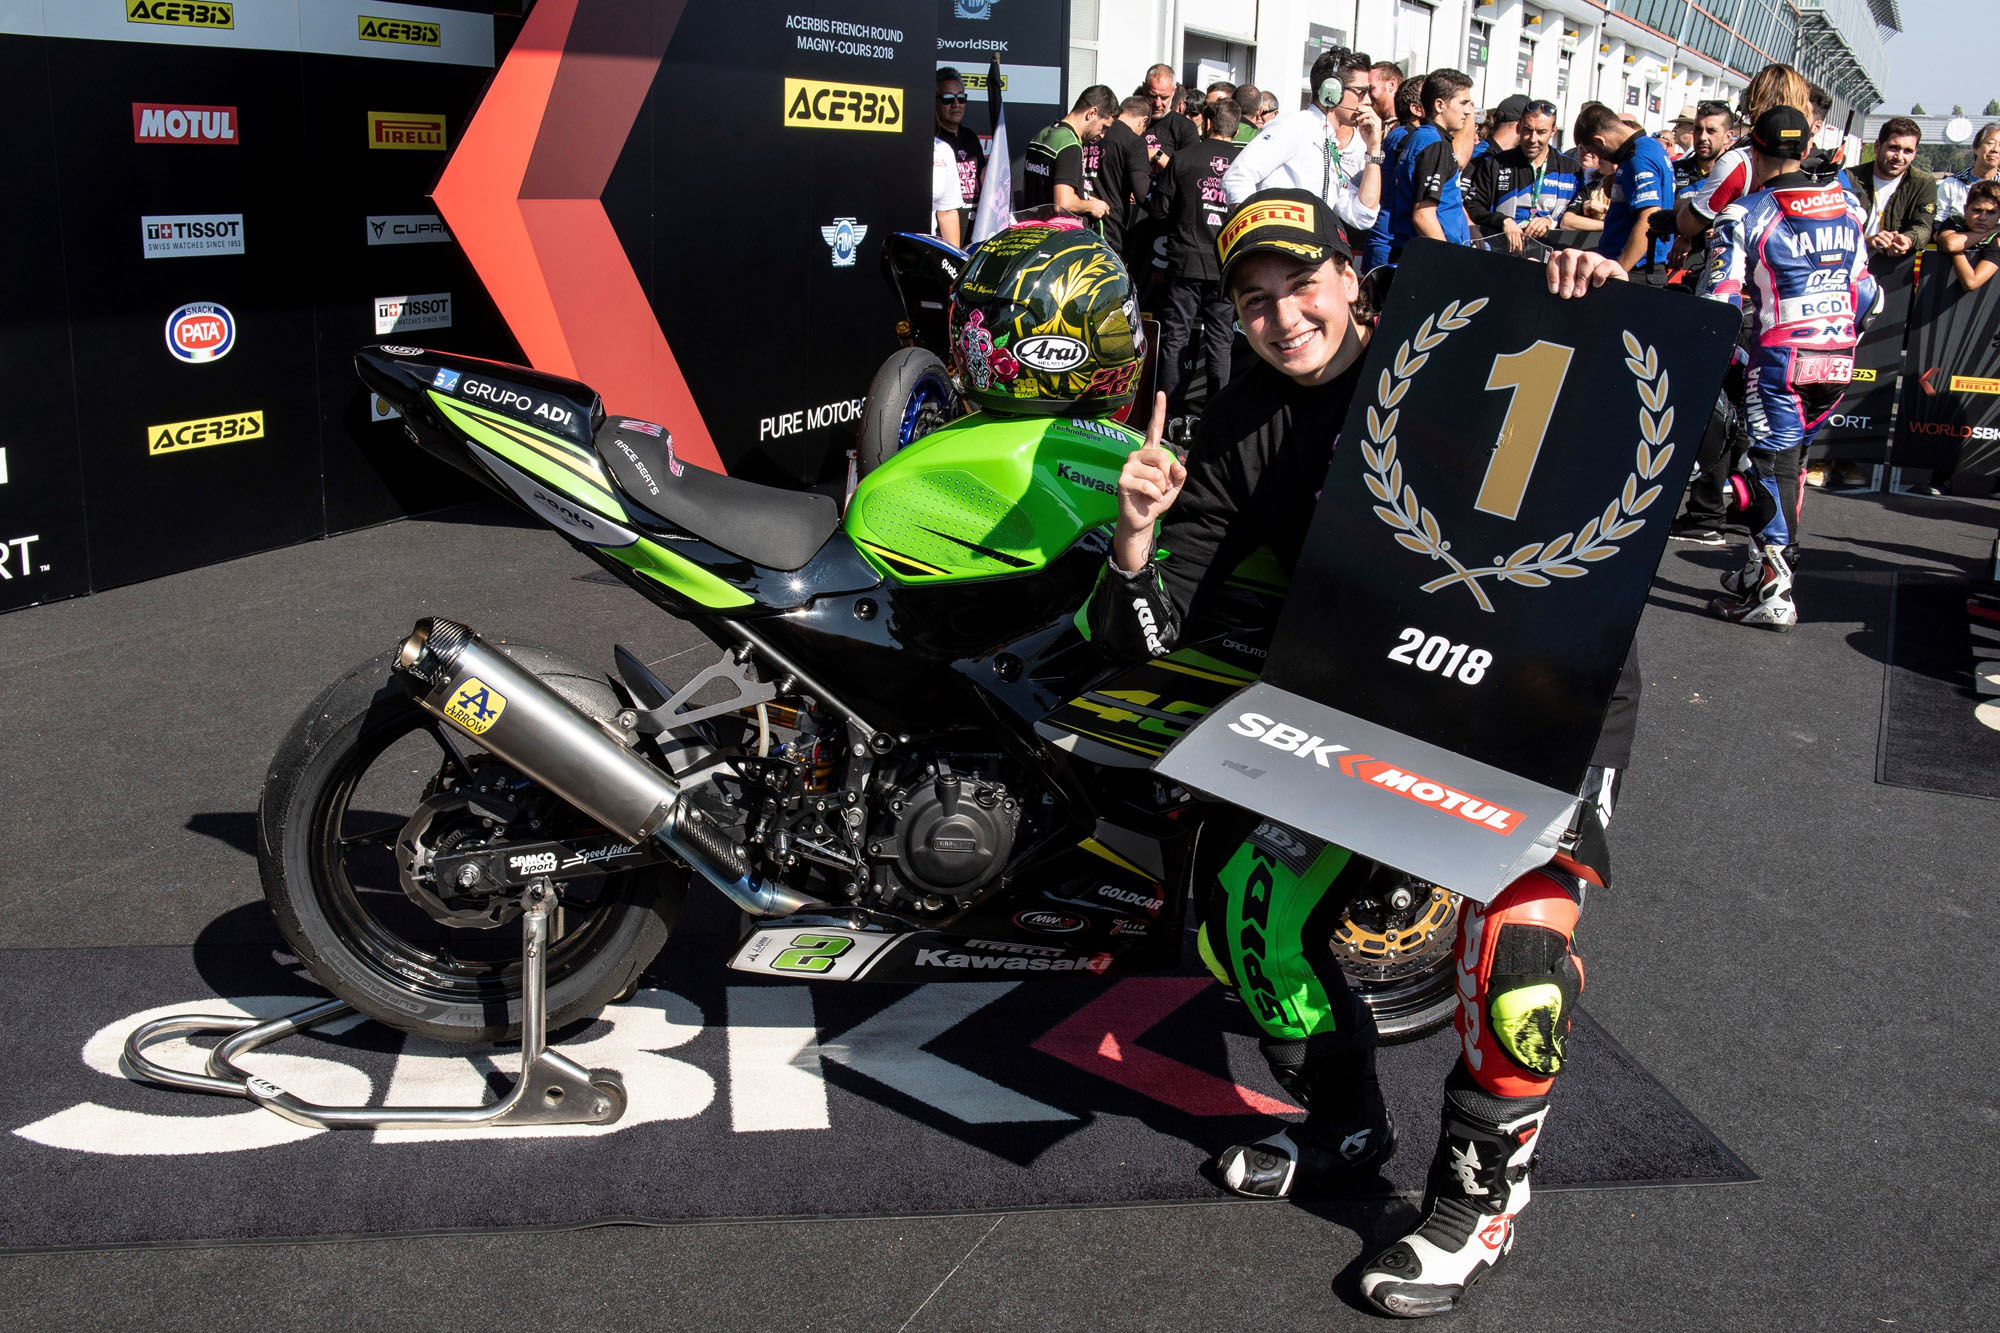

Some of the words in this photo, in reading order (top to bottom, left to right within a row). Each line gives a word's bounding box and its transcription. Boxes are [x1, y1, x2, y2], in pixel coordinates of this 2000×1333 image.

[129, 0, 231, 25] ACERBIS
[360, 20, 438, 43] ACERBIS
[785, 15, 830, 33] ACERBIS
[831, 20, 870, 38] FRENCH
[871, 25, 904, 43] ROUND
[797, 35, 872, 57] MAGNY-COURS
[873, 43, 894, 60] 2018
[788, 86, 900, 125] ACERBIS
[139, 109, 235, 139] MOTUL
[375, 120, 442, 145] PIRELLI
[174, 221, 239, 239] TISSOT
[1221, 203, 1305, 253] PIRELLI
[148, 243, 170, 251] SWISS
[172, 241, 204, 250] WATCHES
[206, 240, 225, 248] SINCE
[186, 305, 214, 316] SNACK
[399, 298, 449, 316] TISSOT
[181, 321, 221, 343] PATA
[1020, 340, 1080, 361] Arai
[462, 379, 532, 412] GRUPO
[533, 402, 573, 426] ADI
[1746, 366, 1773, 440] YAMAHA
[152, 415, 262, 450] ACERBIS
[760, 410, 803, 441] PURE
[1051, 423, 1102, 442] Technologies
[1072, 417, 1130, 445] AKIRA
[1473, 339, 1576, 521] 1
[613, 438, 640, 463] RACE
[634, 461, 661, 496] SEATS
[1057, 462, 1118, 496] Kawas
[1388, 626, 1494, 686] 2018
[445, 705, 487, 733] ARROW
[1227, 711, 1350, 769] SBK
[1371, 768, 1512, 830] MOTUL
[509, 852, 556, 868] SAMCO
[522, 863, 553, 875] sport
[562, 846, 606, 868] Speed
[1097, 884, 1164, 911] GOLDCAR
[914, 948, 1114, 971] Kawasaki
